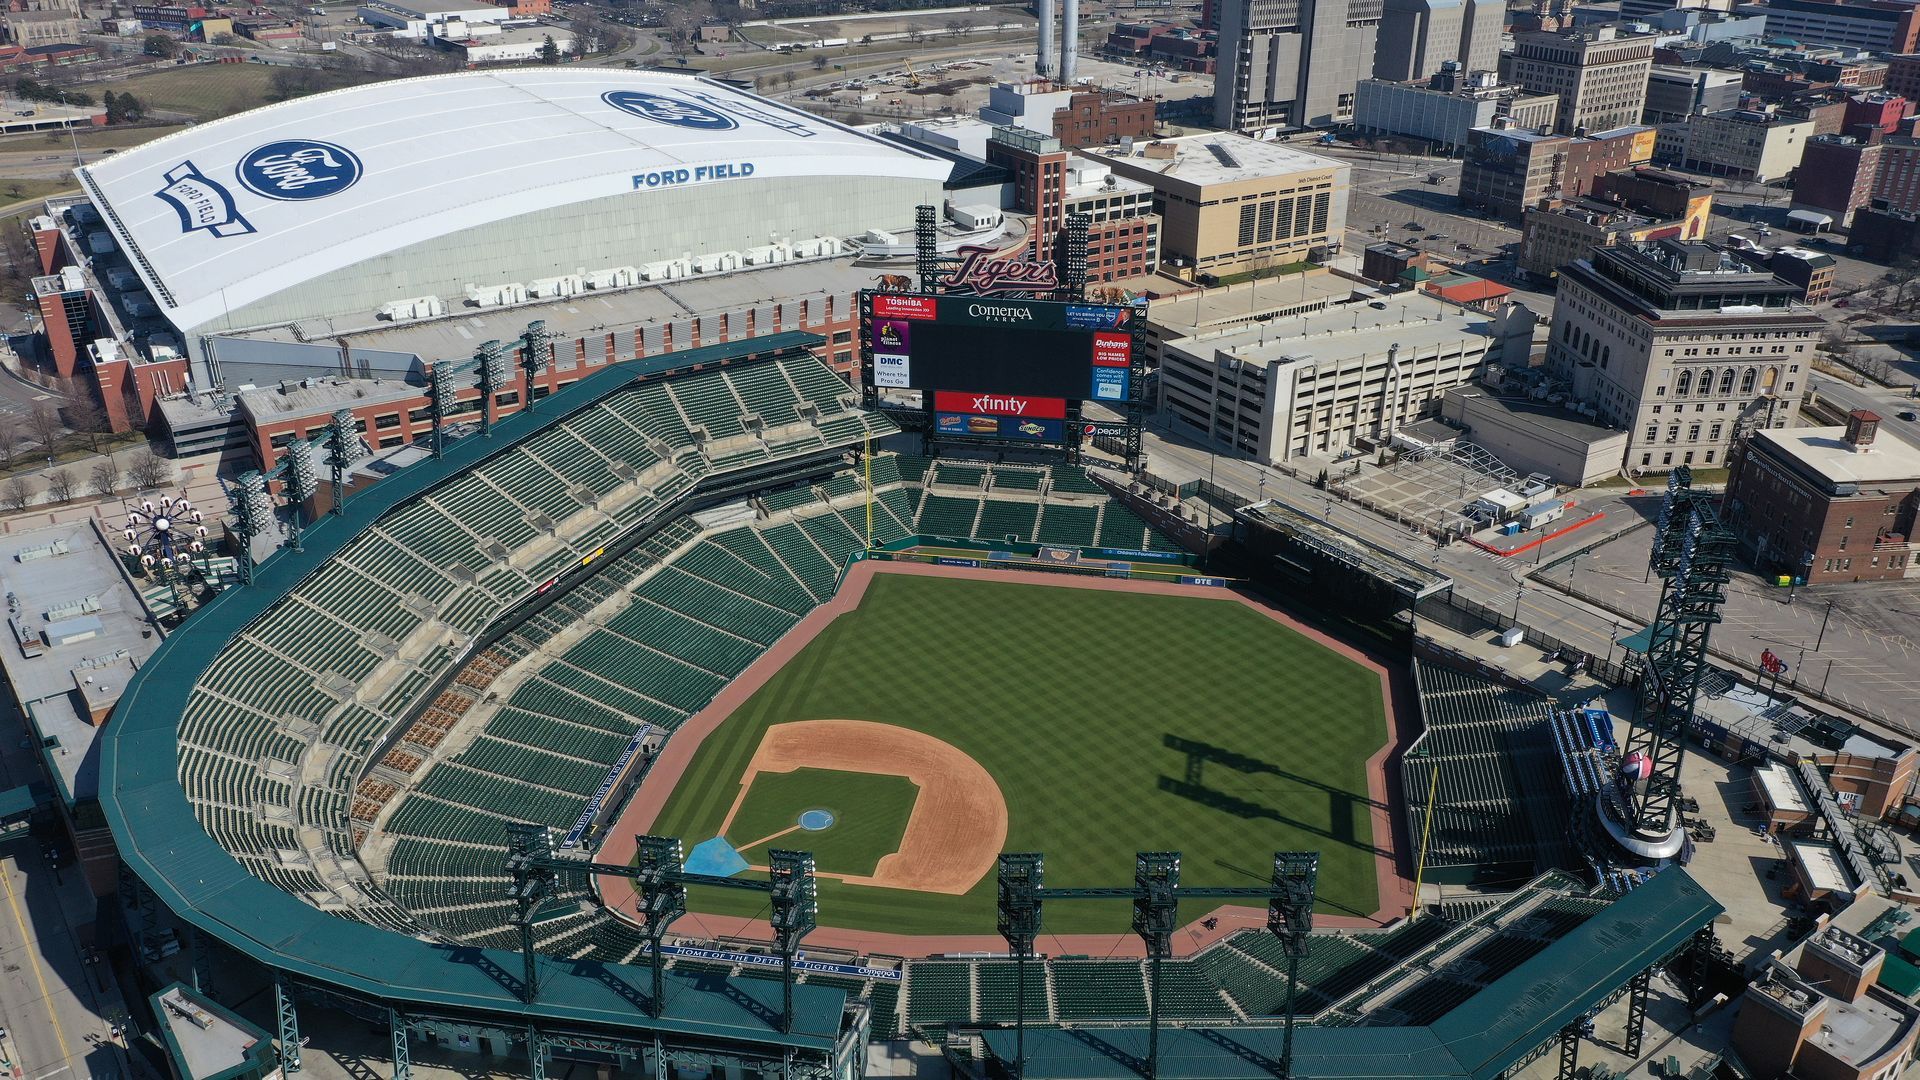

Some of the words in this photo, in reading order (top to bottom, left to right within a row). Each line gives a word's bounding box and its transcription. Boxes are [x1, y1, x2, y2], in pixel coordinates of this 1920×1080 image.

[253, 148, 342, 190] Ford
[631, 168, 690, 189] FORD
[694, 162, 755, 181] FIELD
[172, 184, 201, 201] FORD
[198, 199, 216, 224] FIELD
[945, 245, 1059, 297] Tigers
[886, 298, 922, 307] TOSHIBA
[986, 315, 1016, 323] PARK
[880, 357, 903, 365] DMC
[972, 395, 1027, 415] xfinity
[1019, 425, 1045, 433] SUNOCO
[1097, 428, 1121, 436] pepsi
[676, 948, 709, 958] HOME
[730, 954, 750, 962] THE
[753, 957, 800, 968] DETRT
[804, 961, 840, 972] TIGERS
